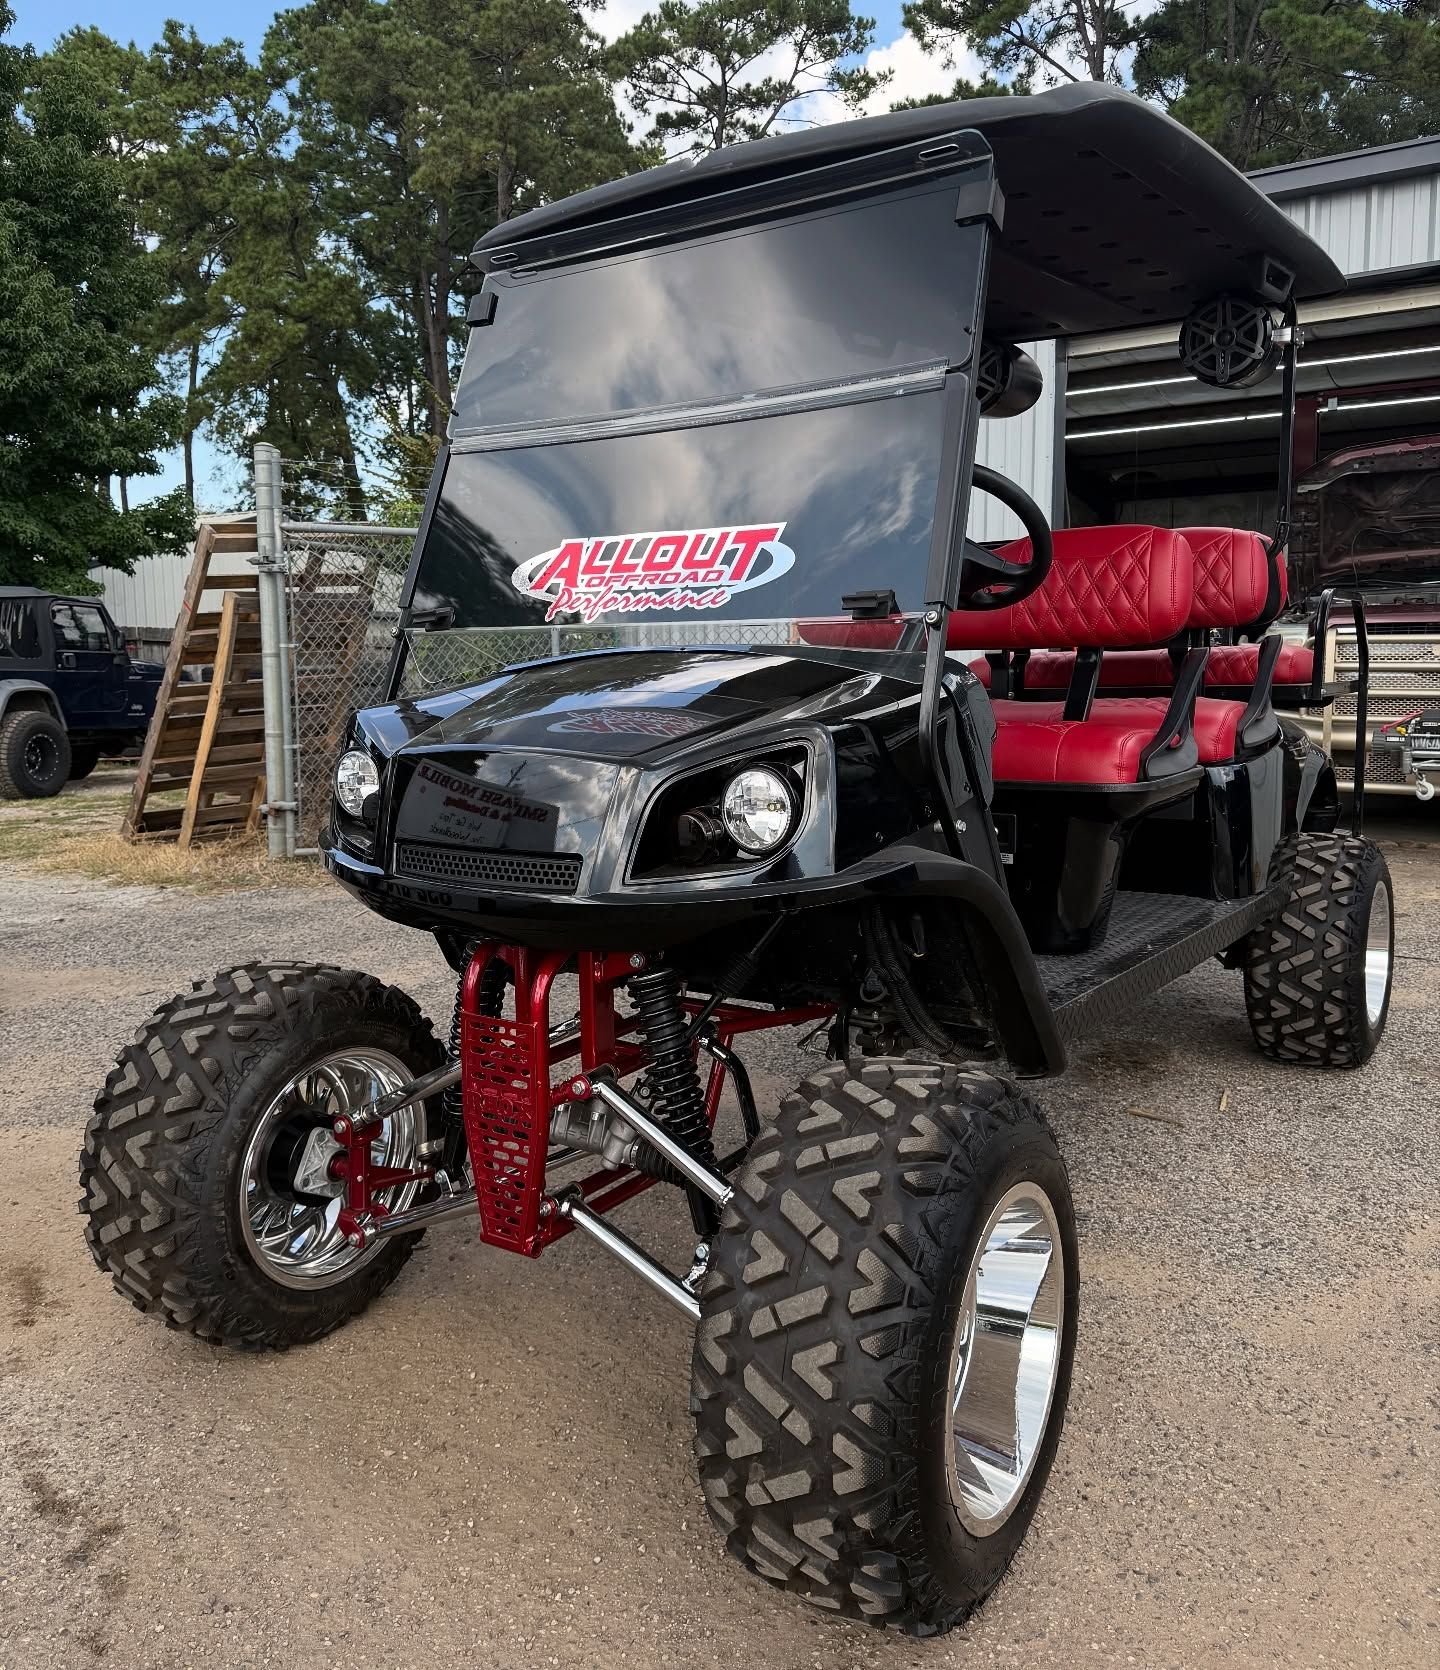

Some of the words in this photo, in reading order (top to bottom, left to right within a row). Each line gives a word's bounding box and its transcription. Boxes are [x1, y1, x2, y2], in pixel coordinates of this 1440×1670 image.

[529, 526, 781, 590] ALLOUT
[584, 568, 726, 588] OFFROAD
[545, 587, 729, 622] Performance
